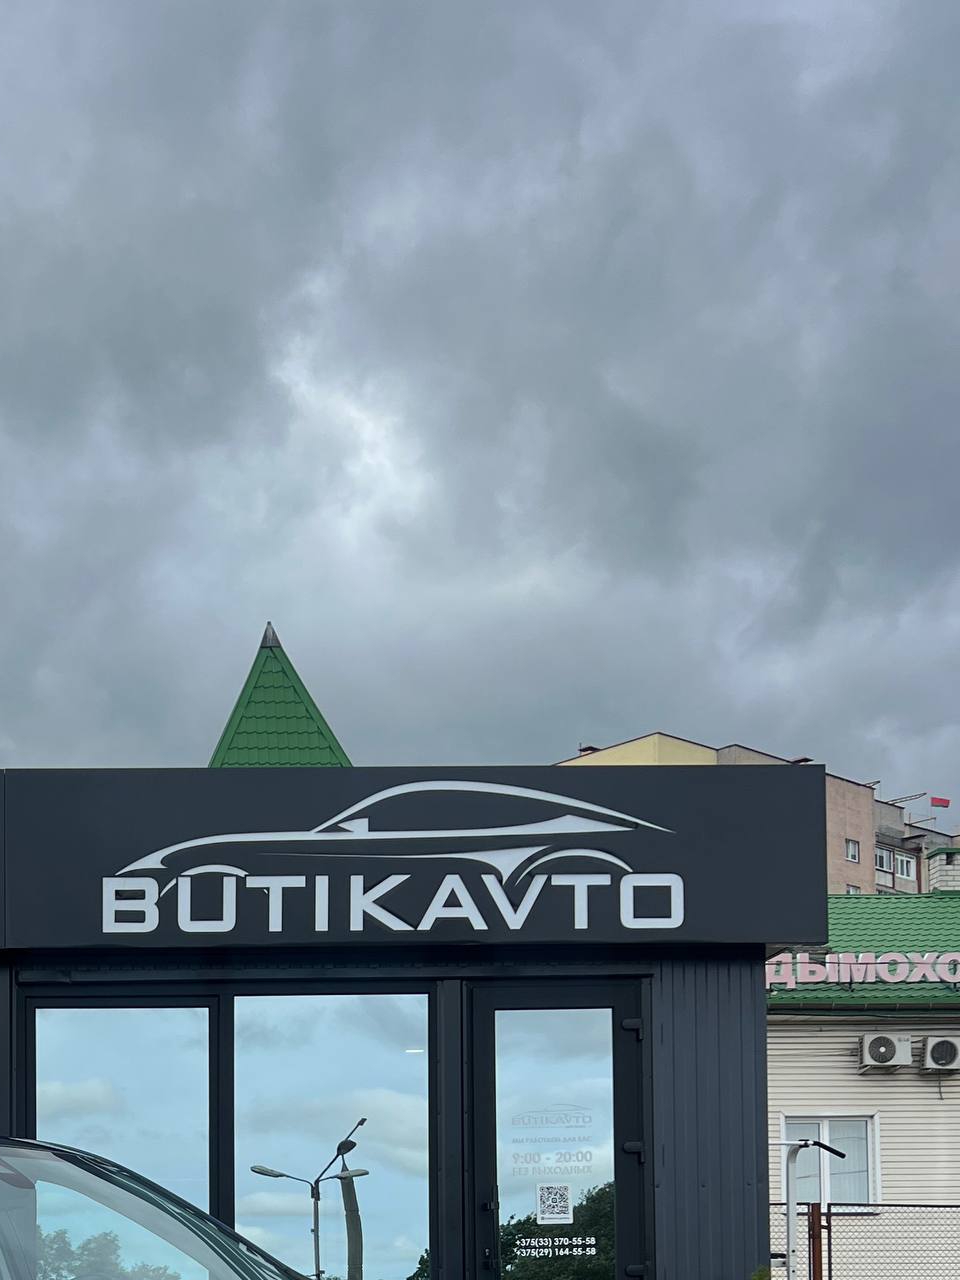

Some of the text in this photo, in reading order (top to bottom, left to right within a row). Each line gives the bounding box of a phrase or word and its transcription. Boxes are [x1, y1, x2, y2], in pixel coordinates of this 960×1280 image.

[101, 872, 685, 933] BUTIKAVTO
[765, 952, 960, 989] ДЫМОХО
[512, 1152, 541, 1164] 9:00
[555, 1150, 592, 1163] 20:00
[515, 1237, 596, 1248] +375(33) 370-55-58
[516, 1247, 596, 1258] +375(29) 164-55-58
